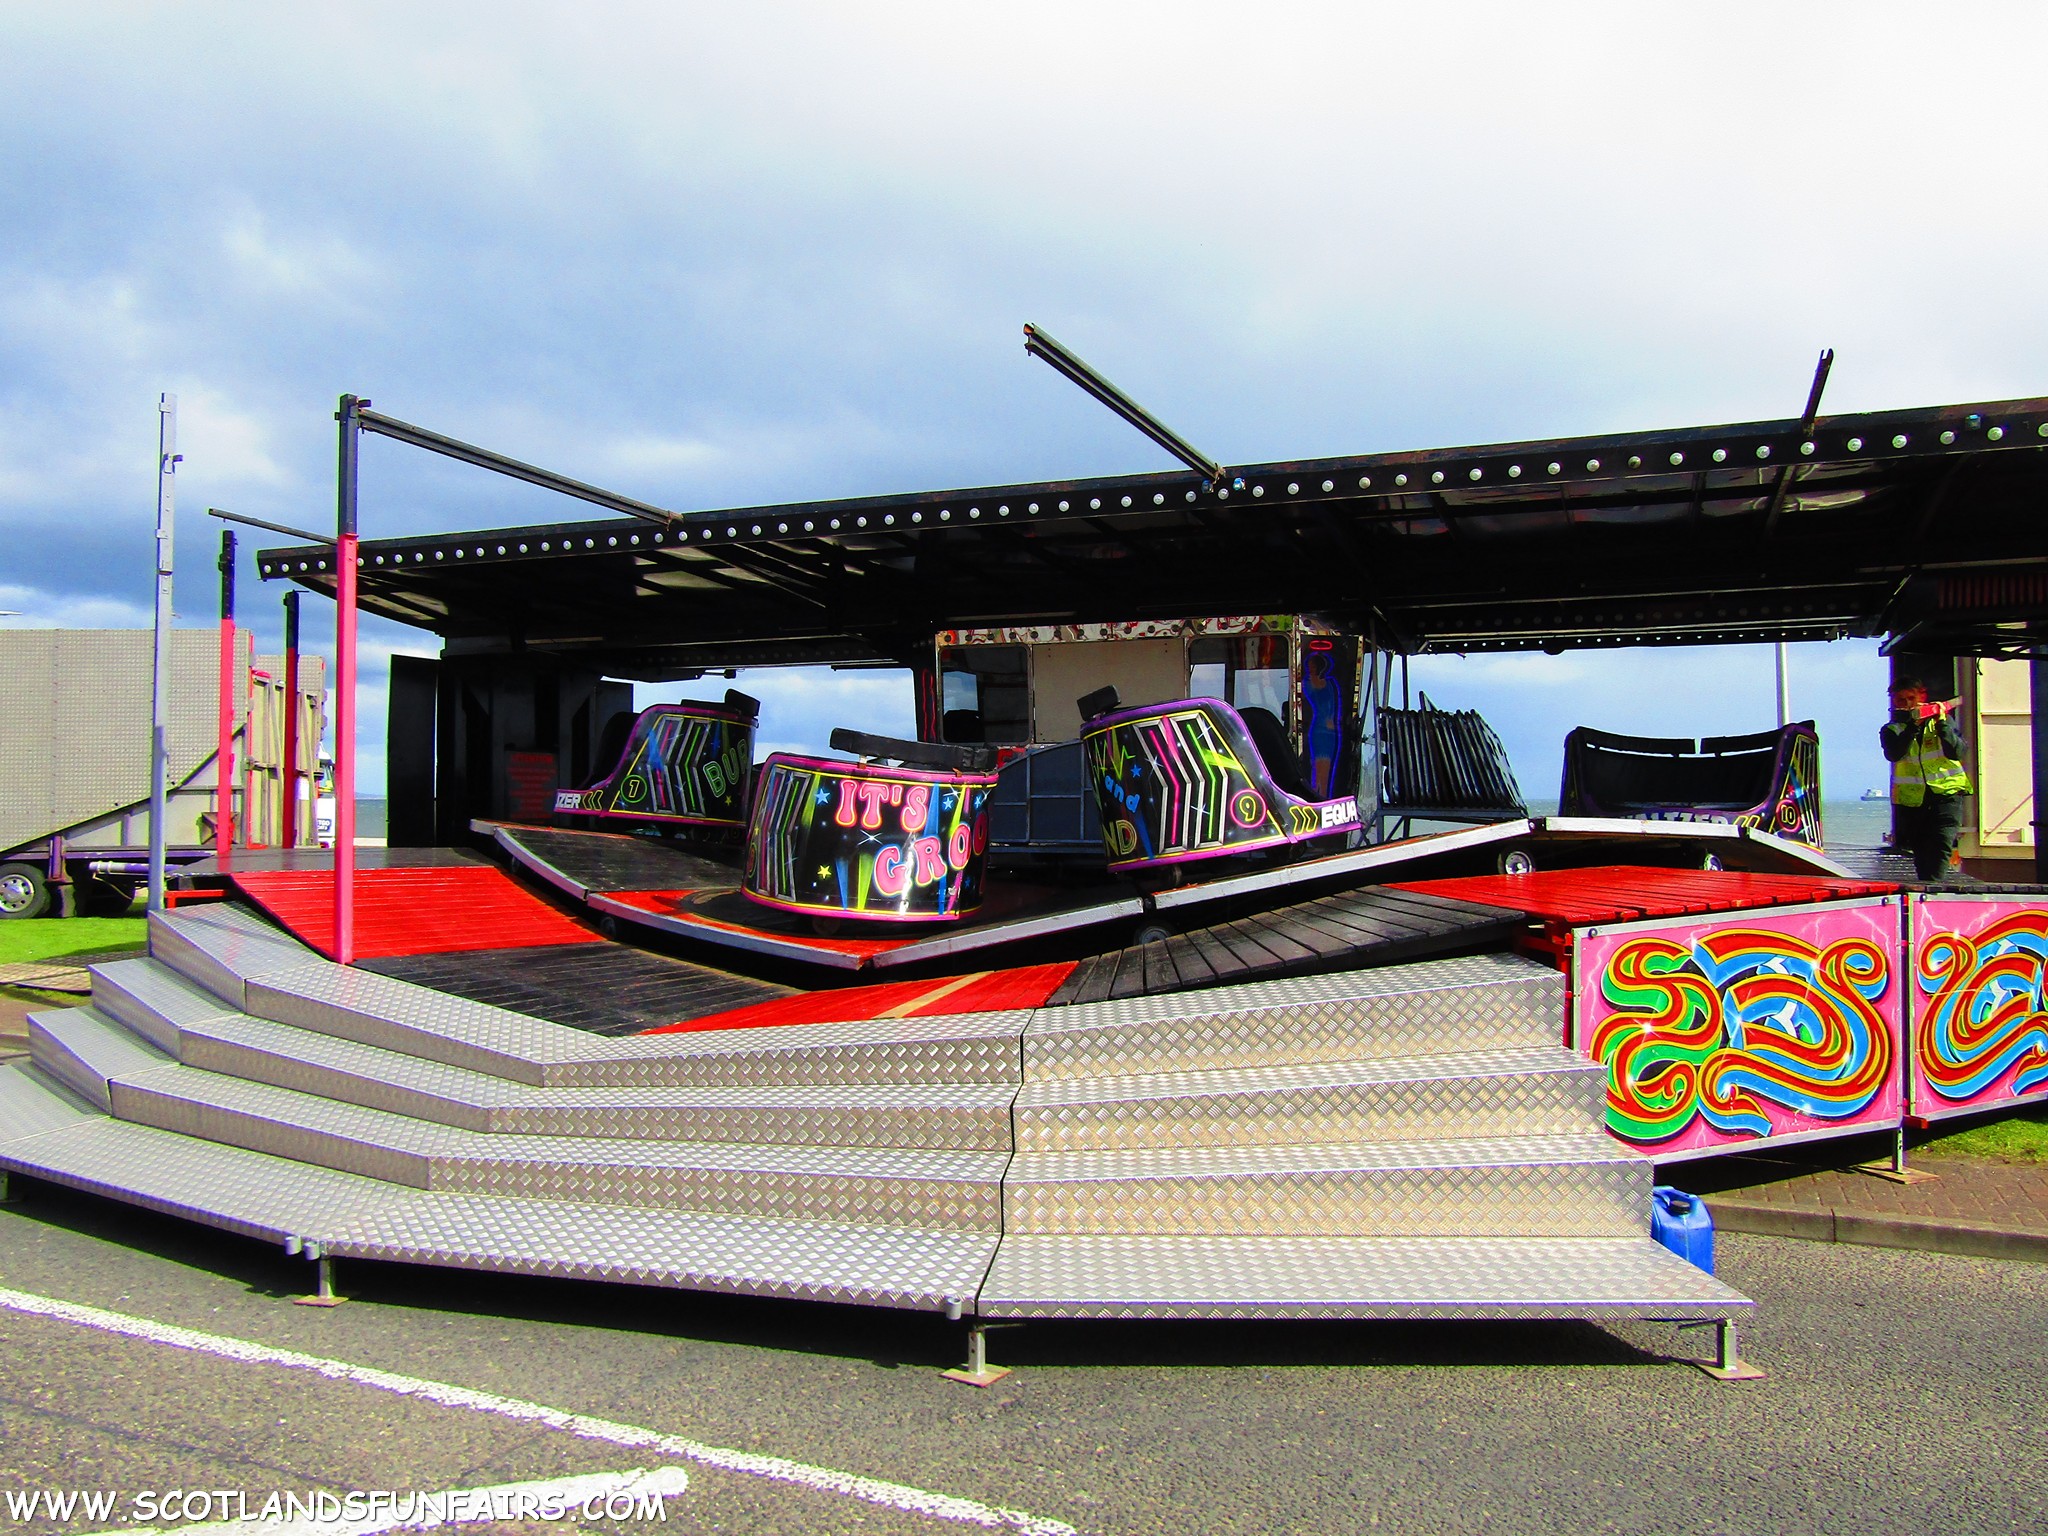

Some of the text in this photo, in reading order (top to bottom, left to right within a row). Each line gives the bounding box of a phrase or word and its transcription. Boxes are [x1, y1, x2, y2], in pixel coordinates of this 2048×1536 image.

[629, 780, 638, 798] 1
[1105, 774, 1141, 814] and
[834, 779, 930, 833] IT'S
[1238, 795, 1257, 822] 9
[1321, 800, 1358, 829] EQUA
[1780, 804, 1796, 826] 10
